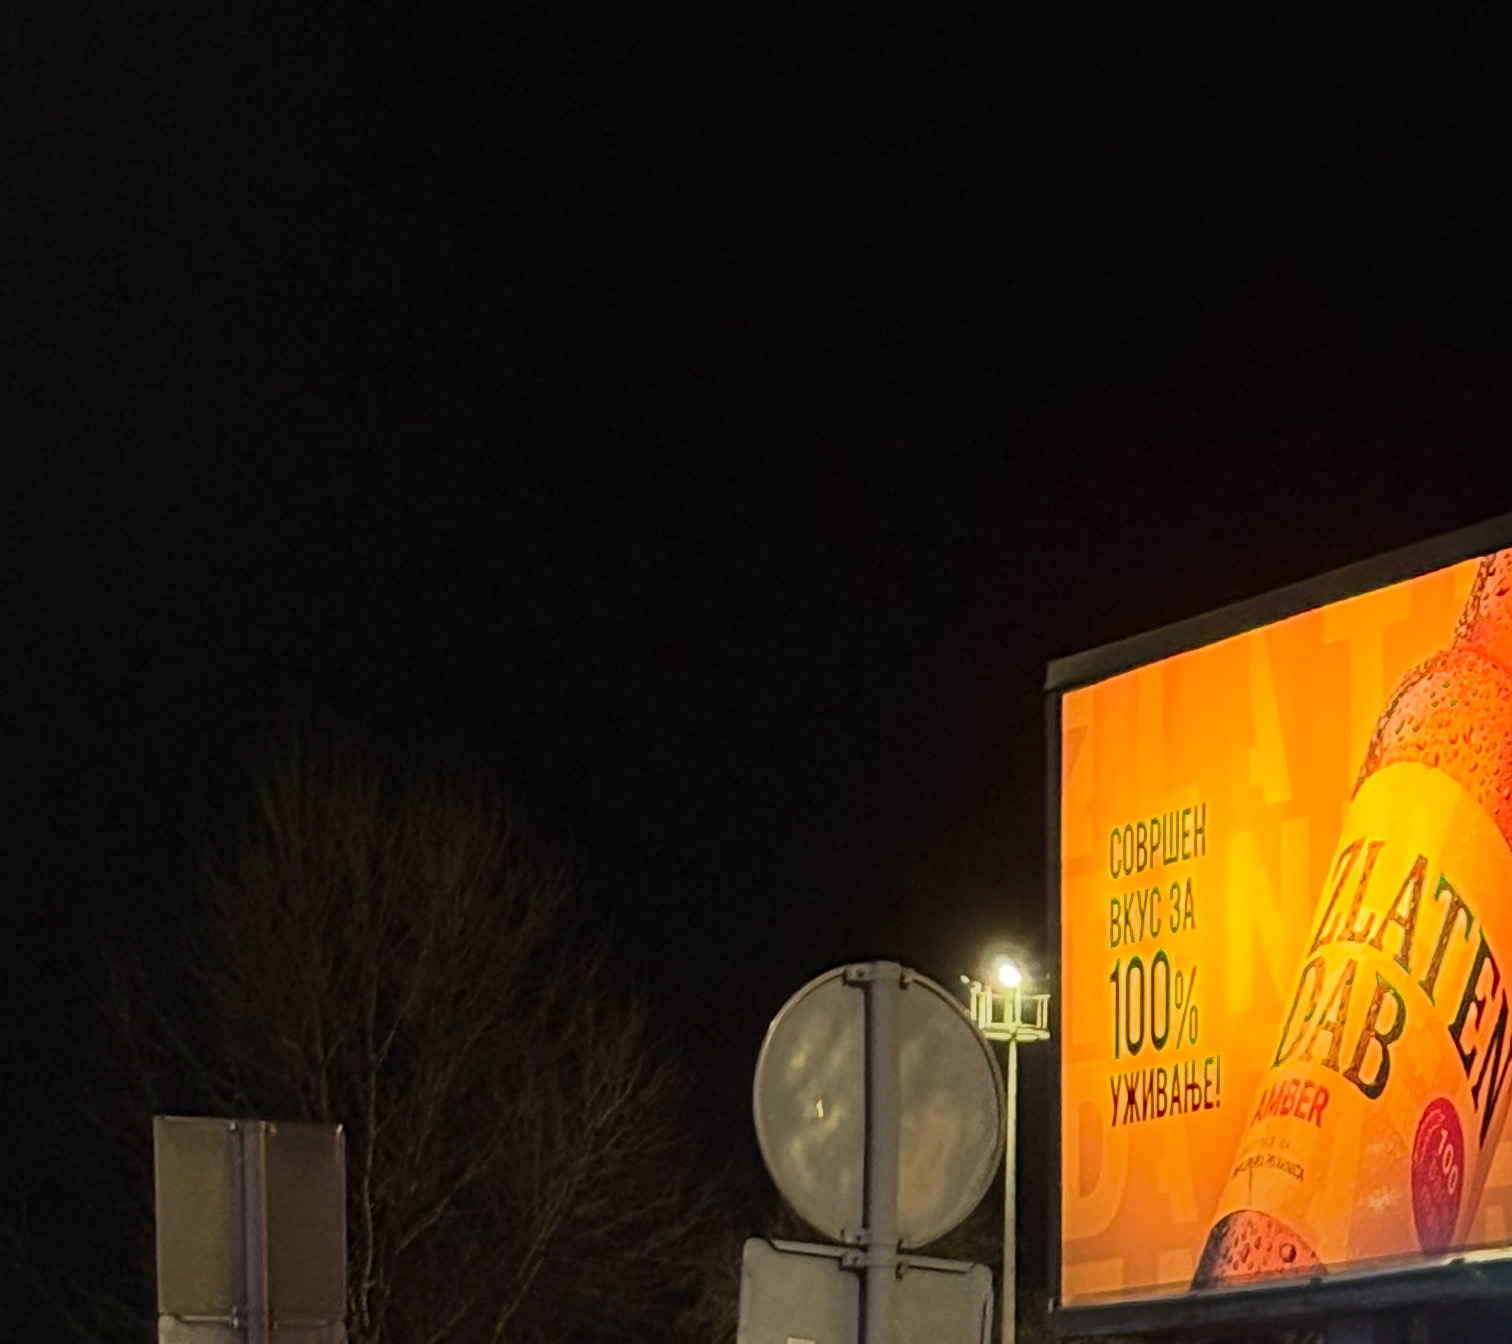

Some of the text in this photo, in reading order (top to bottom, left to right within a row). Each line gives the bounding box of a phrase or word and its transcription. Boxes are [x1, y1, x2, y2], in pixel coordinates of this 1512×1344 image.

[1109, 801, 1207, 880] СОВРШЕН
[1109, 877, 1196, 949] ВКУС ЗА
[1108, 947, 1199, 1061] 100%
[1270, 955, 1408, 1101] DAB
[1109, 1054, 1222, 1128] УЖИВАЊЕ!
[1249, 1077, 1330, 1129] AMBER
